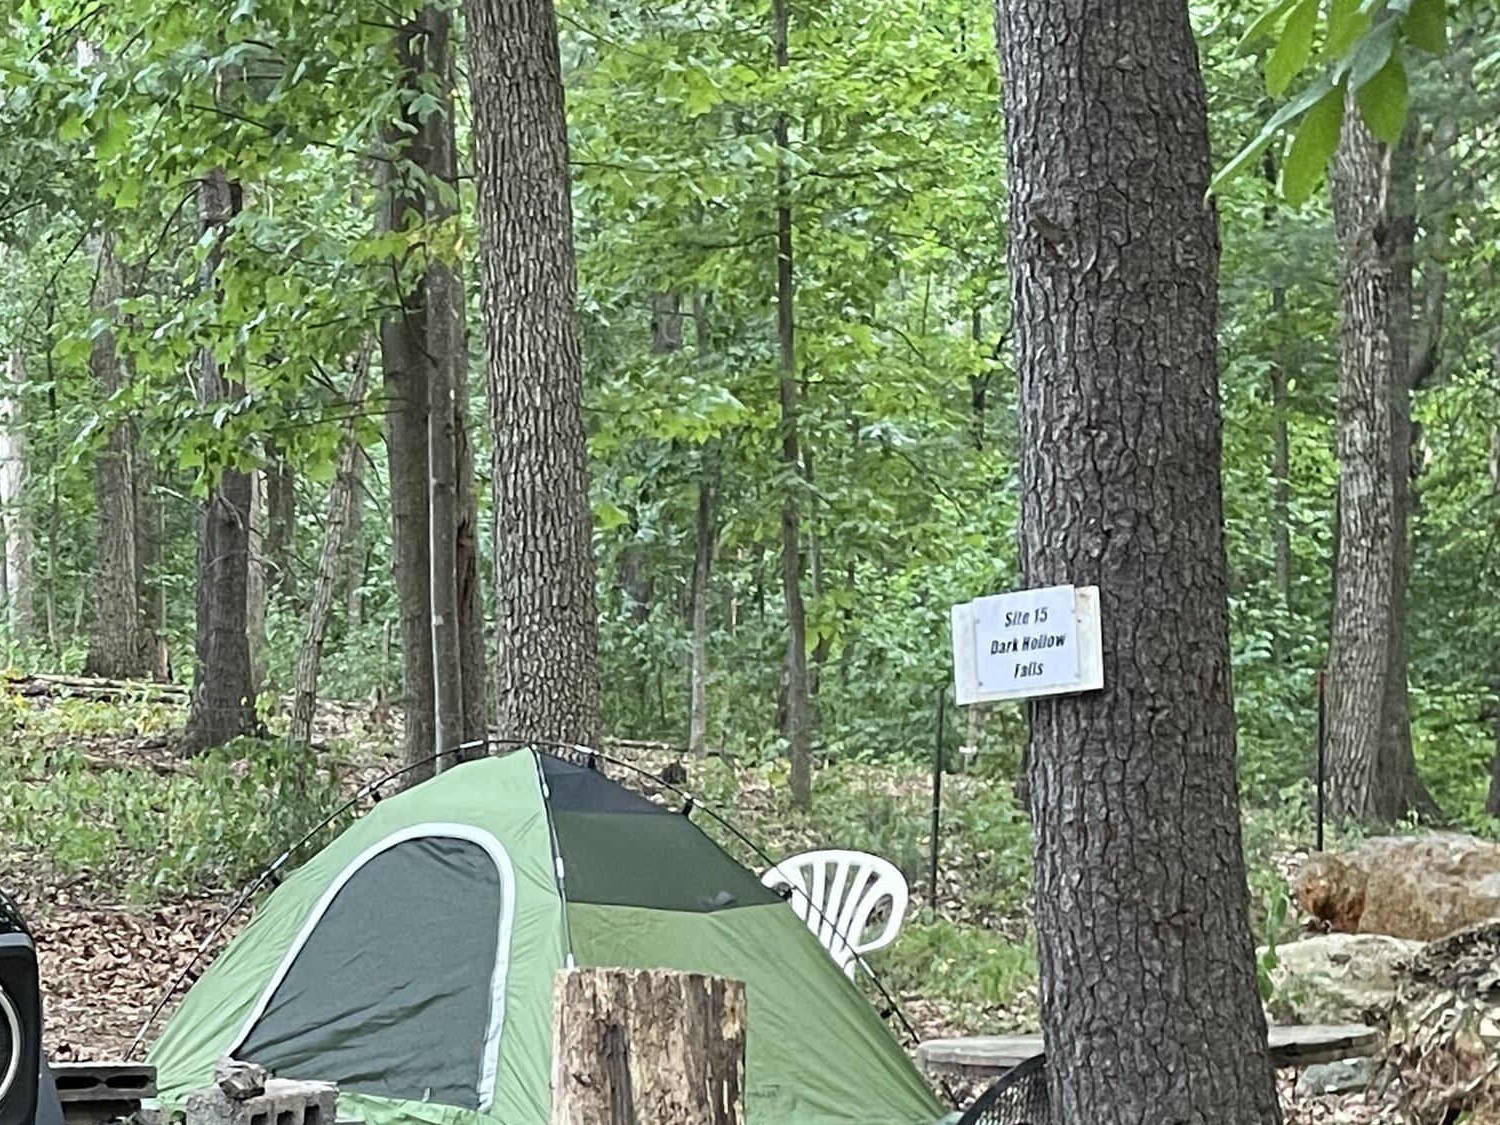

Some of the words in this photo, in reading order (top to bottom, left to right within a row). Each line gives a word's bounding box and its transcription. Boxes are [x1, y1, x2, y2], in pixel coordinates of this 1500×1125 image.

[1004, 610, 1030, 627] Site
[1034, 607, 1048, 623] 15
[990, 638, 1018, 655] Dark
[1021, 634, 1067, 652] Hollow
[1013, 661, 1044, 678] Falls
